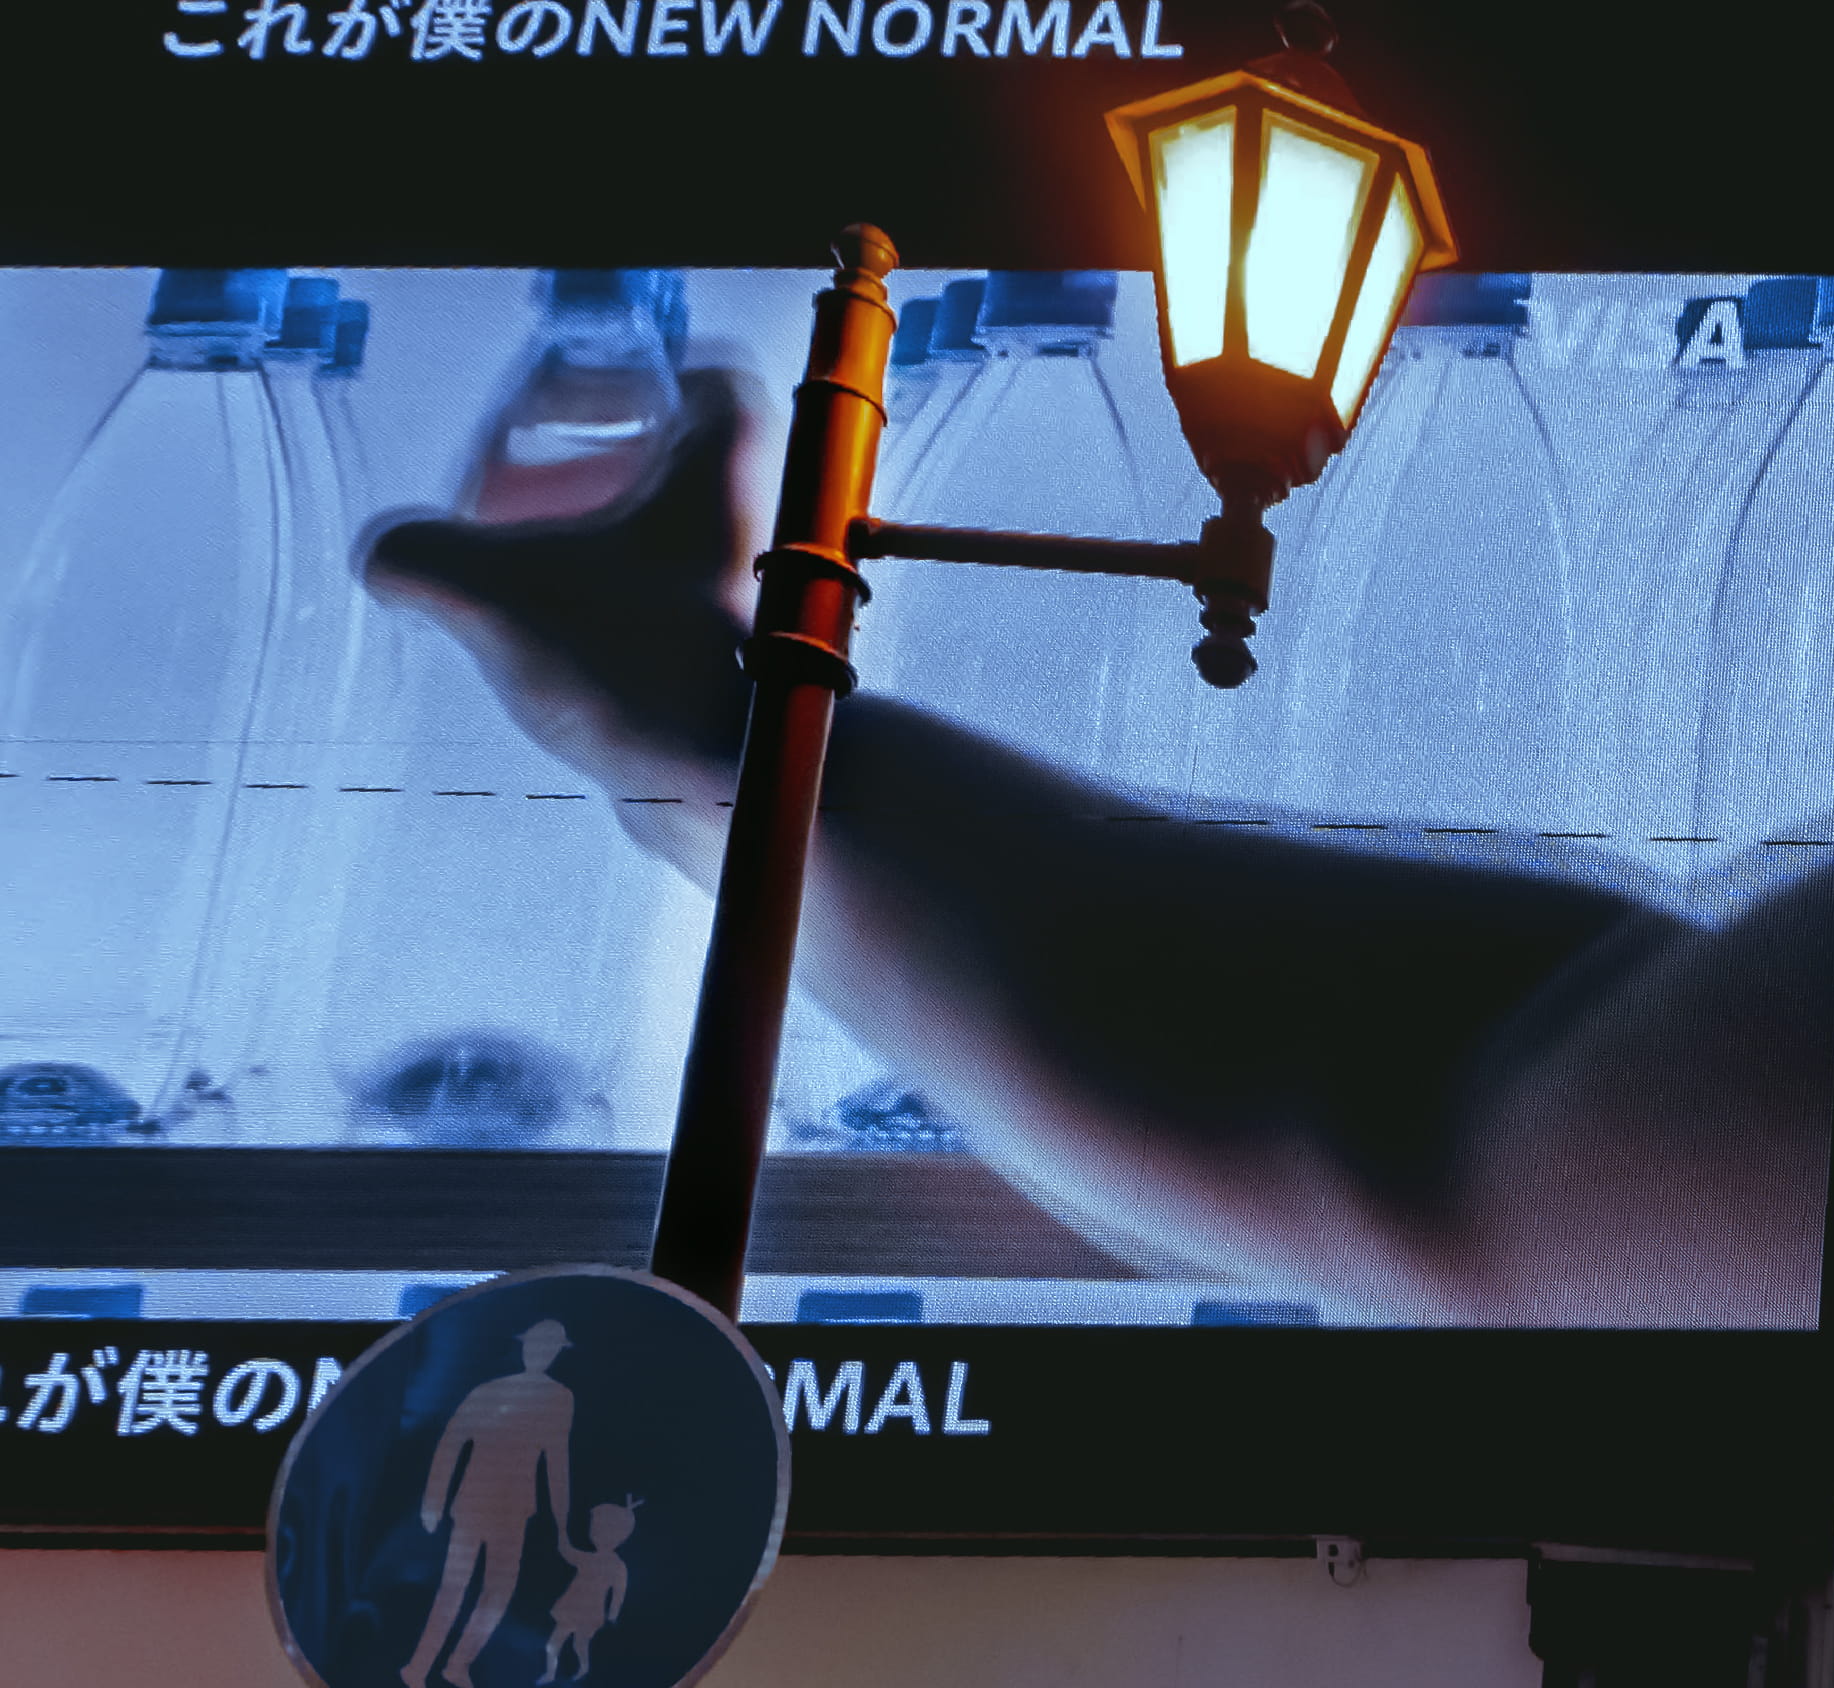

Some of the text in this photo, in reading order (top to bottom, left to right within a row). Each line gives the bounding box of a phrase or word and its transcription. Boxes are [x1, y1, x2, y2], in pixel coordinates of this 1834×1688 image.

[803, 0, 1184, 57] NORMAL
[0, 1345, 992, 1437] が僕の MAL
